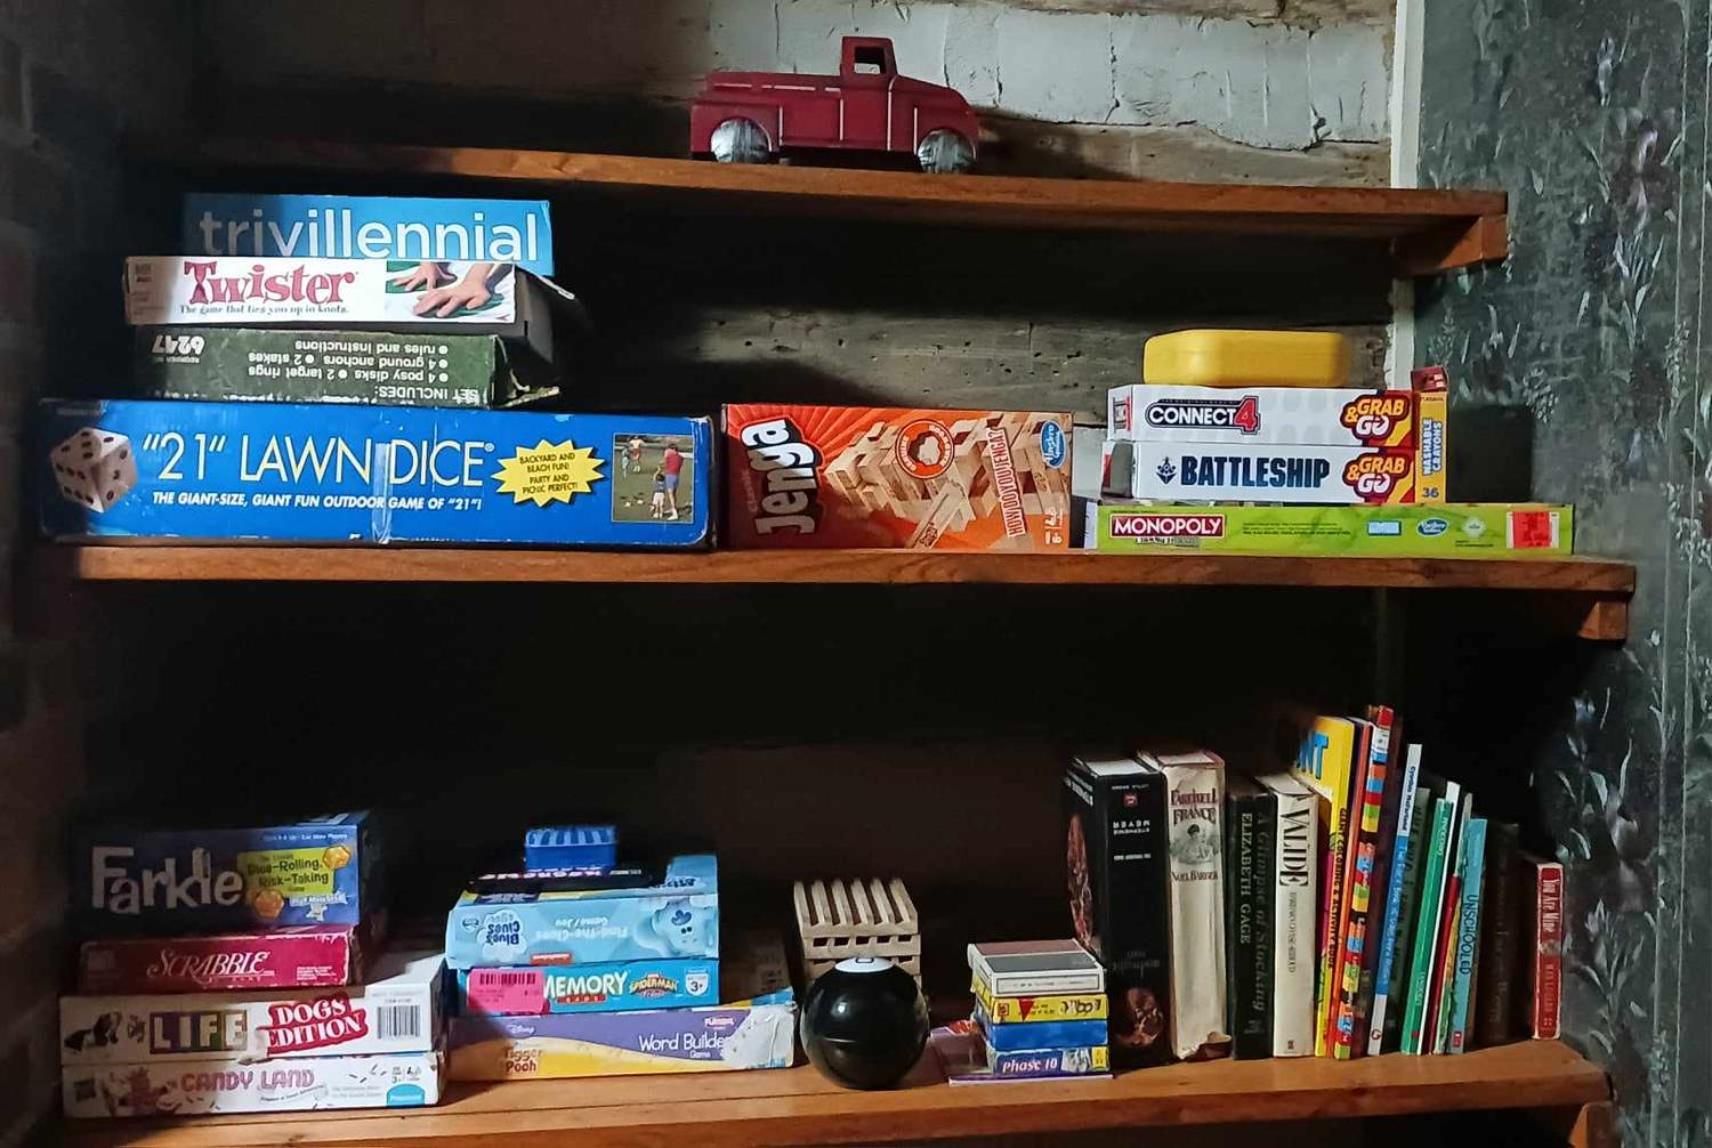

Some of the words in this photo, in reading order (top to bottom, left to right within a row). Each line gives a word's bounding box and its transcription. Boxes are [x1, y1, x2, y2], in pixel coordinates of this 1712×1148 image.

[200, 207, 538, 260] trivillennial
[183, 260, 356, 305] Twister
[180, 305, 196, 314] The
[199, 306, 223, 315] game
[226, 304, 244, 314] that
[247, 304, 265, 314] ties
[267, 306, 288, 315] you
[152, 335, 206, 355] 6247
[295, 340, 373, 355] instructions
[376, 343, 400, 354] and
[405, 345, 437, 354] rules
[248, 353, 290, 365] stakes
[294, 355, 302, 364] 2
[323, 356, 372, 368] anchors
[377, 357, 424, 370] ground
[429, 358, 437, 368] 4
[248, 365, 280, 379] rings
[286, 368, 322, 381] target
[327, 368, 336, 379] 2
[354, 370, 388, 381] disks
[397, 370, 424, 383] posy
[429, 371, 437, 381] 4
[374, 387, 449, 401] INCLUDES:
[453, 388, 478, 402] SET
[1149, 406, 1237, 426] CONNECT
[1234, 397, 1258, 432] 4
[1344, 407, 1358, 423] &
[1357, 399, 1405, 416] GRAB
[1422, 418, 1433, 476] WASHABLE
[1433, 421, 1443, 472] CRAYONS
[240, 434, 372, 485] LAWN
[519, 454, 557, 464] BACKYARD
[1359, 457, 1406, 474] GRAB
[527, 464, 550, 472] BEACH
[1181, 456, 1330, 488] BATTLESHIP
[1346, 464, 1359, 481] &
[529, 475, 550, 483] PARTY
[740, 418, 817, 536] Jenga
[152, 491, 174, 504] THE
[178, 492, 248, 508] GIANT-SIZE,
[252, 494, 292, 507] GIANT
[294, 495, 320, 508] FUN
[323, 496, 385, 509] OUTDOOR
[387, 497, 425, 510] GAME
[427, 498, 445, 510] OF
[1421, 486, 1440, 499] 36
[1114, 517, 1222, 535] MONOPOLY
[1240, 813, 1253, 896] ELIZABETH
[1333, 840, 1344, 887] COLORING
[91, 847, 244, 915] Farkle
[258, 872, 330, 887] Risk-Taking
[1542, 878, 1560, 894] You
[1542, 895, 1560, 911] Are
[1239, 903, 1252, 944] GAGE
[1327, 897, 1339, 942] ACTIVITY
[1541, 911, 1559, 933] Mine
[487, 921, 520, 936] Clues
[1459, 894, 1479, 975] UNSCHOOLED
[489, 931, 520, 945] Blue's
[146, 949, 271, 982] SCRABBLE
[274, 999, 346, 1027] DOGS
[152, 1012, 248, 1051] LIFE
[267, 1012, 364, 1048] EDITION
[638, 1032, 680, 1052] Word
[683, 1031, 728, 1050] Builde
[503, 1047, 543, 1062] Tigger
[505, 1060, 537, 1073] Pooh
[1044, 1057, 1058, 1069] 10
[180, 1069, 254, 1094] CANDY
[259, 1068, 316, 1090] LAND
